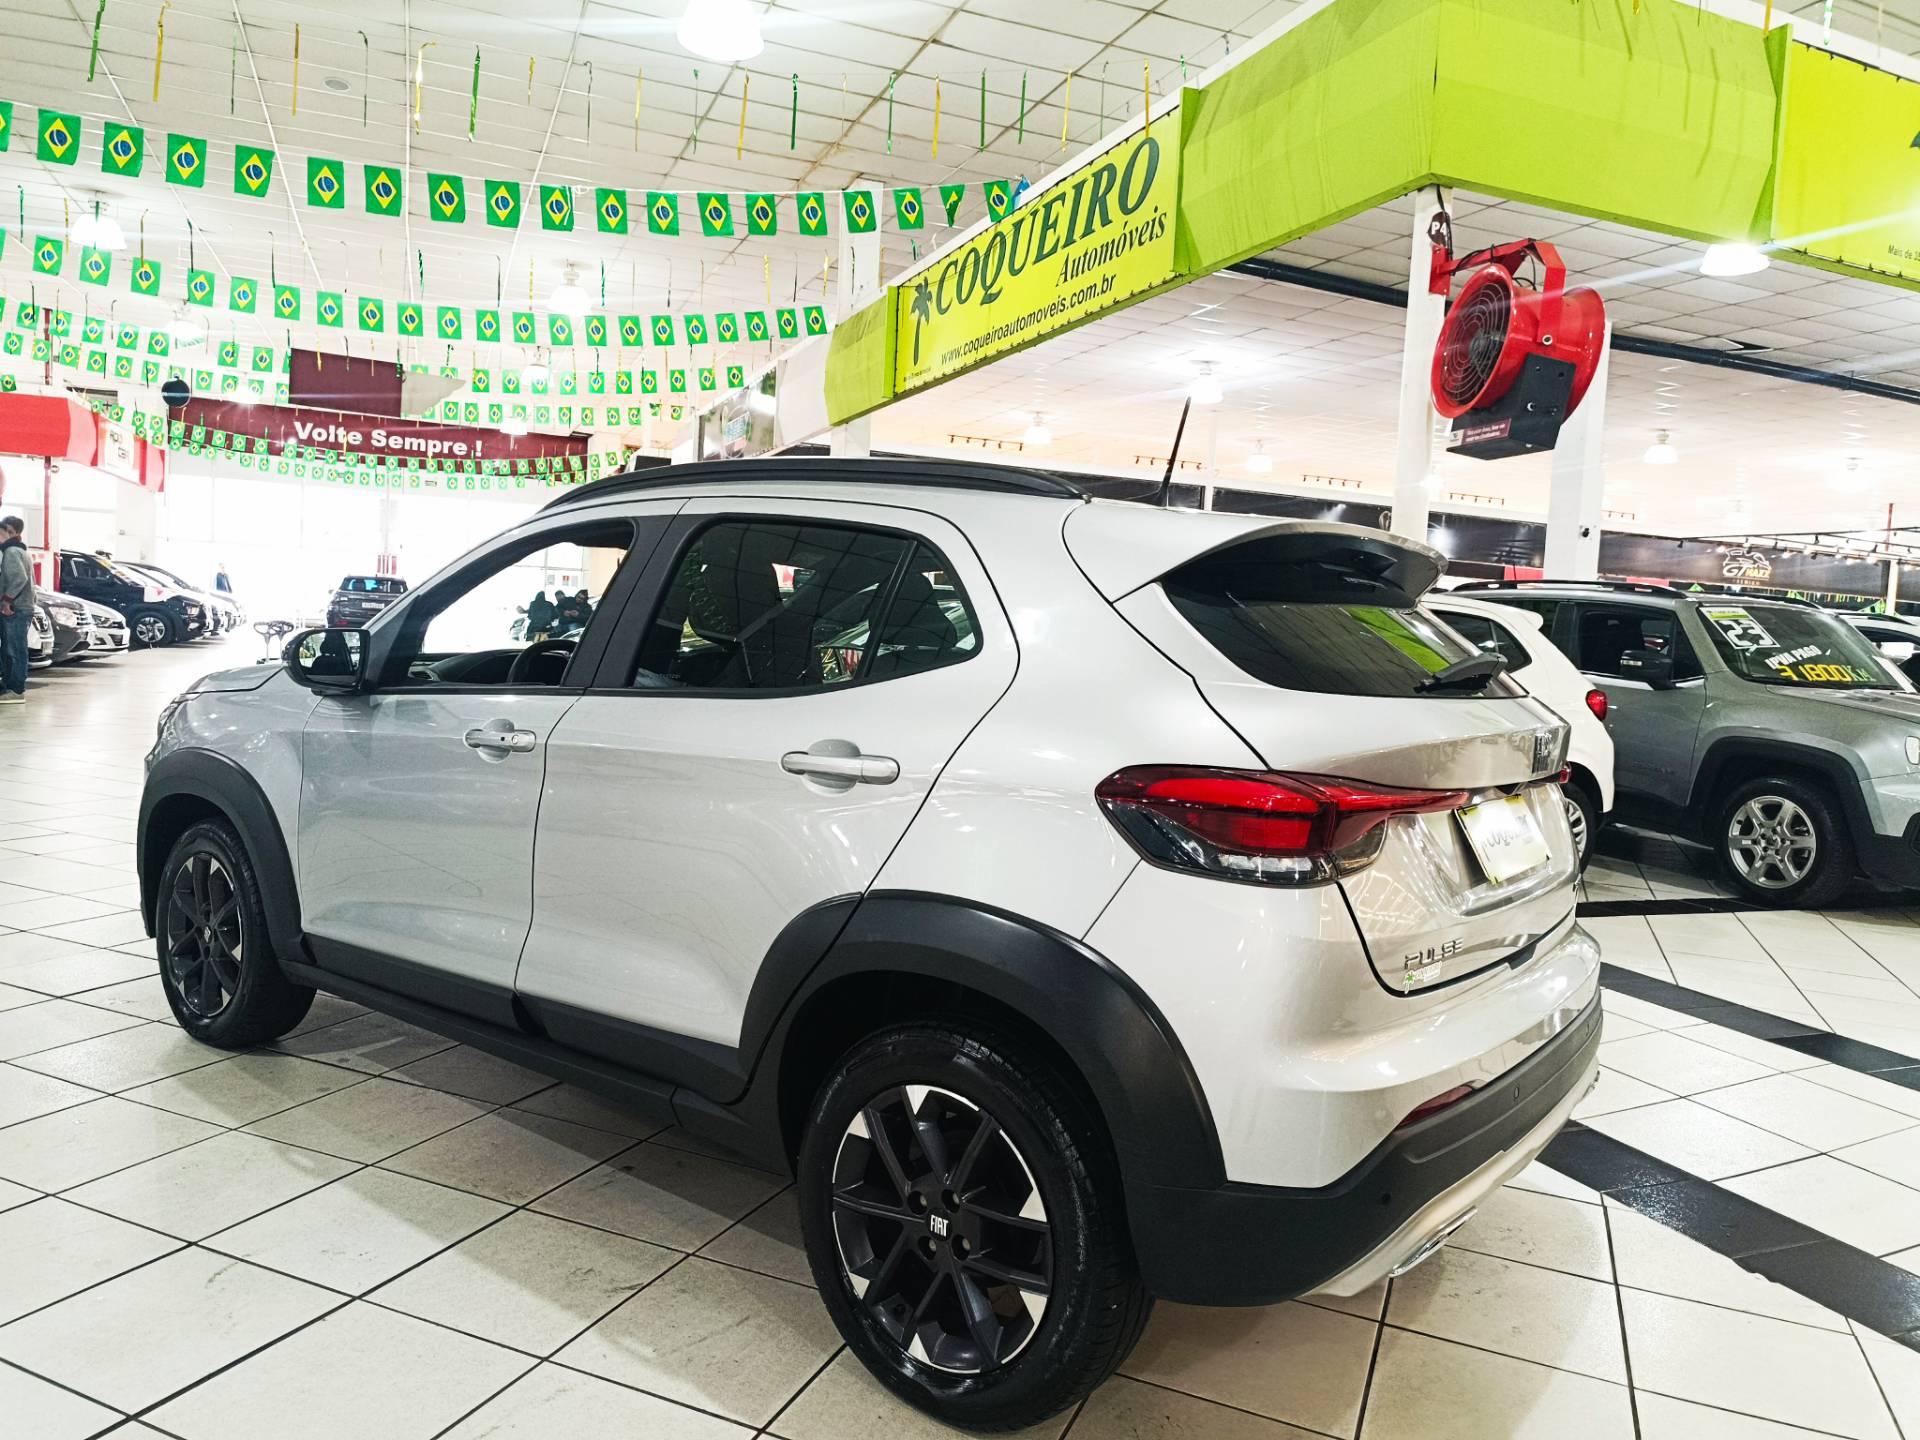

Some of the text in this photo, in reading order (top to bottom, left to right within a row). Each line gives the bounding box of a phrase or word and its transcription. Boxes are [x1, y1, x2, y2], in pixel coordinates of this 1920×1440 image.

[936, 137, 1160, 316] COQUEIRO
[1431, 221, 1448, 236] P4
[1055, 205, 1167, 287] Automóveis
[941, 273, 1117, 366] www.coqueiroautomoveis.com.br
[293, 421, 363, 445] Volte
[370, 429, 468, 456] Sempre
[1718, 619, 1775, 647] 23
[1790, 645, 1823, 661] PAGO
[1405, 937, 1464, 970] PULSE
[931, 1214, 949, 1237] FIAT
